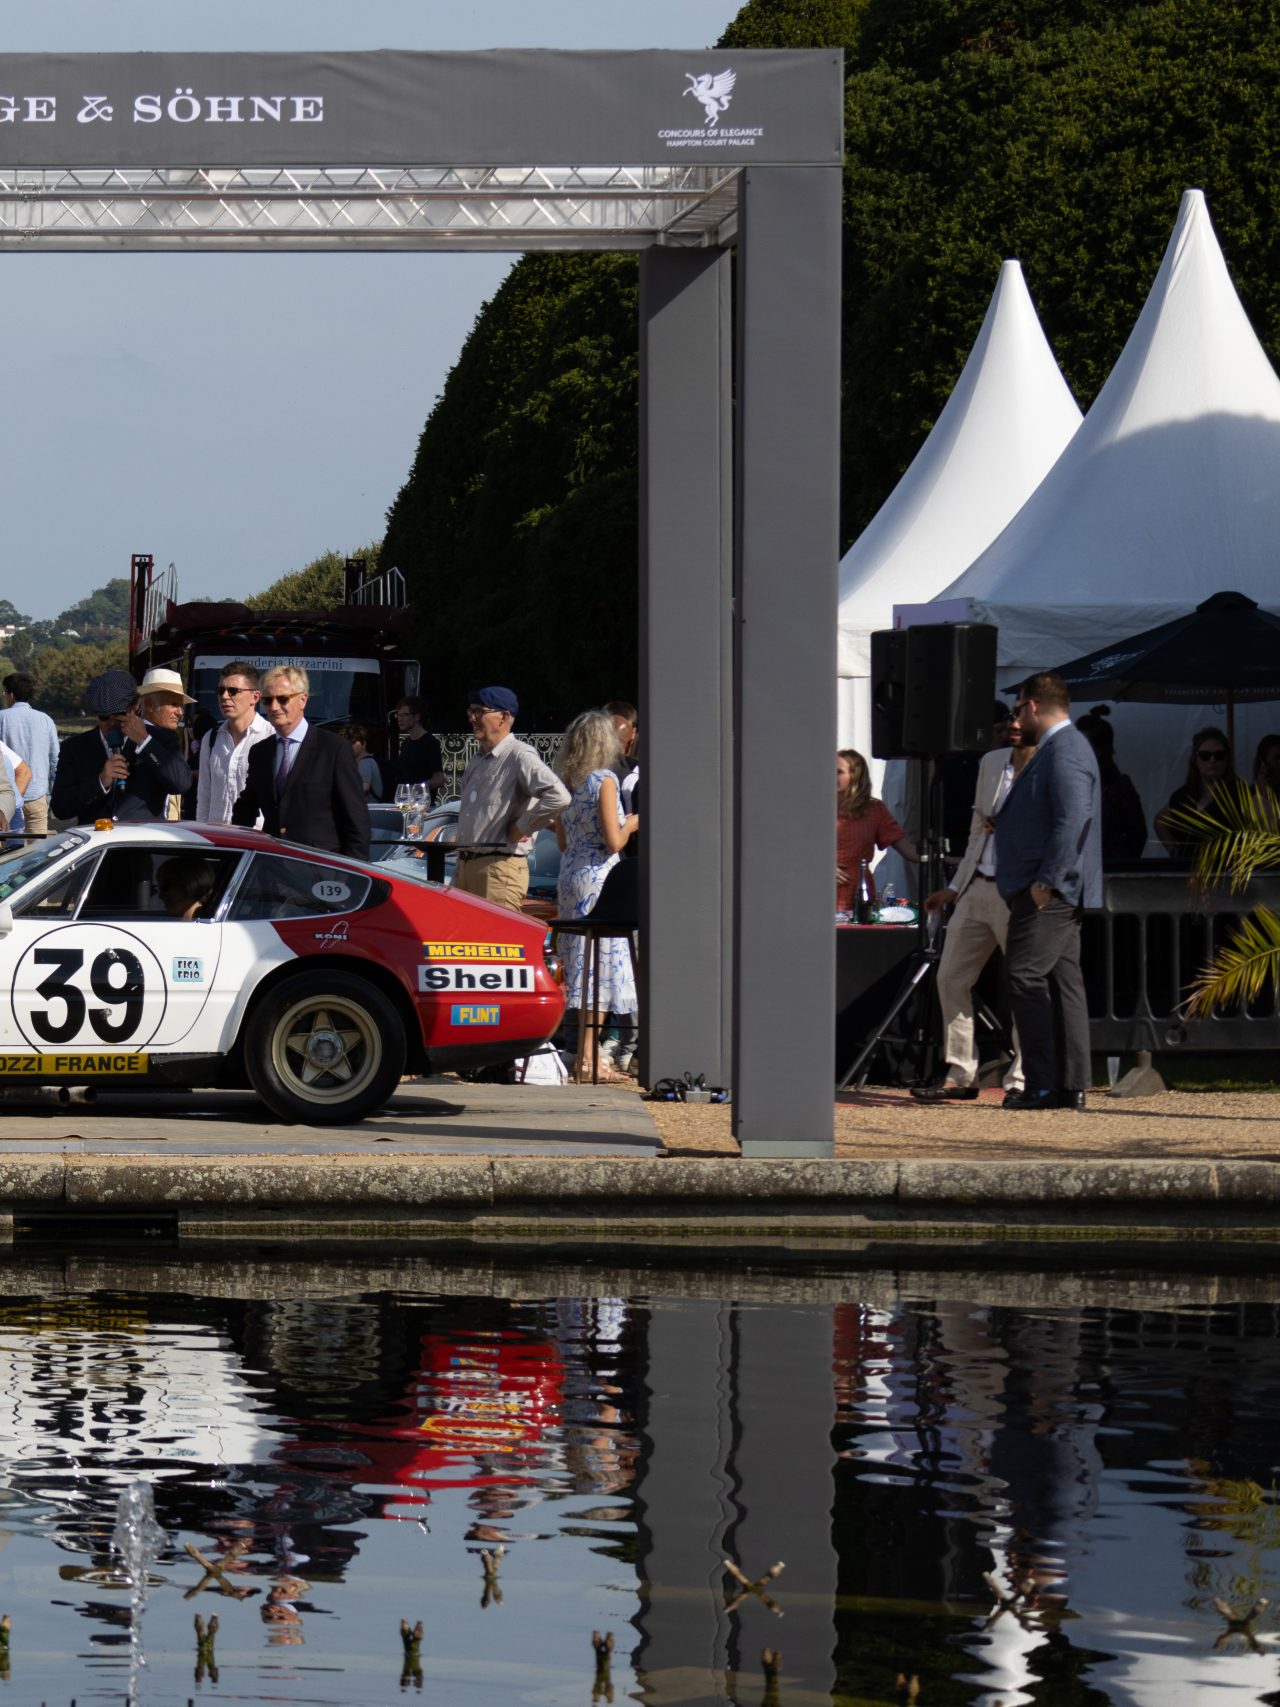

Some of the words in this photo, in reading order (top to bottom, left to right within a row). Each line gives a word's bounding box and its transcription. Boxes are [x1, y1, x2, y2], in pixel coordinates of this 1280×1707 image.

[76, 95, 114, 124] &
[133, 87, 324, 123] SÖHNE
[657, 129, 706, 139] CONCOURS
[706, 129, 719, 137] OF
[719, 127, 764, 137] ELEGANCE
[666, 139, 702, 147] HAMPTON
[703, 138, 727, 146] COURT
[728, 138, 756, 146] PALACE
[235, 656, 283, 668] Suderia
[287, 657, 344, 670] Bizzarrini
[320, 885, 343, 897] 139
[314, 932, 348, 940] KONI
[427, 945, 521, 958] MICHELIN
[424, 967, 528, 990] Shell
[29, 947, 145, 1044] 39
[459, 1007, 499, 1024] FLINT
[54, 1055, 140, 1072] FRANCE
